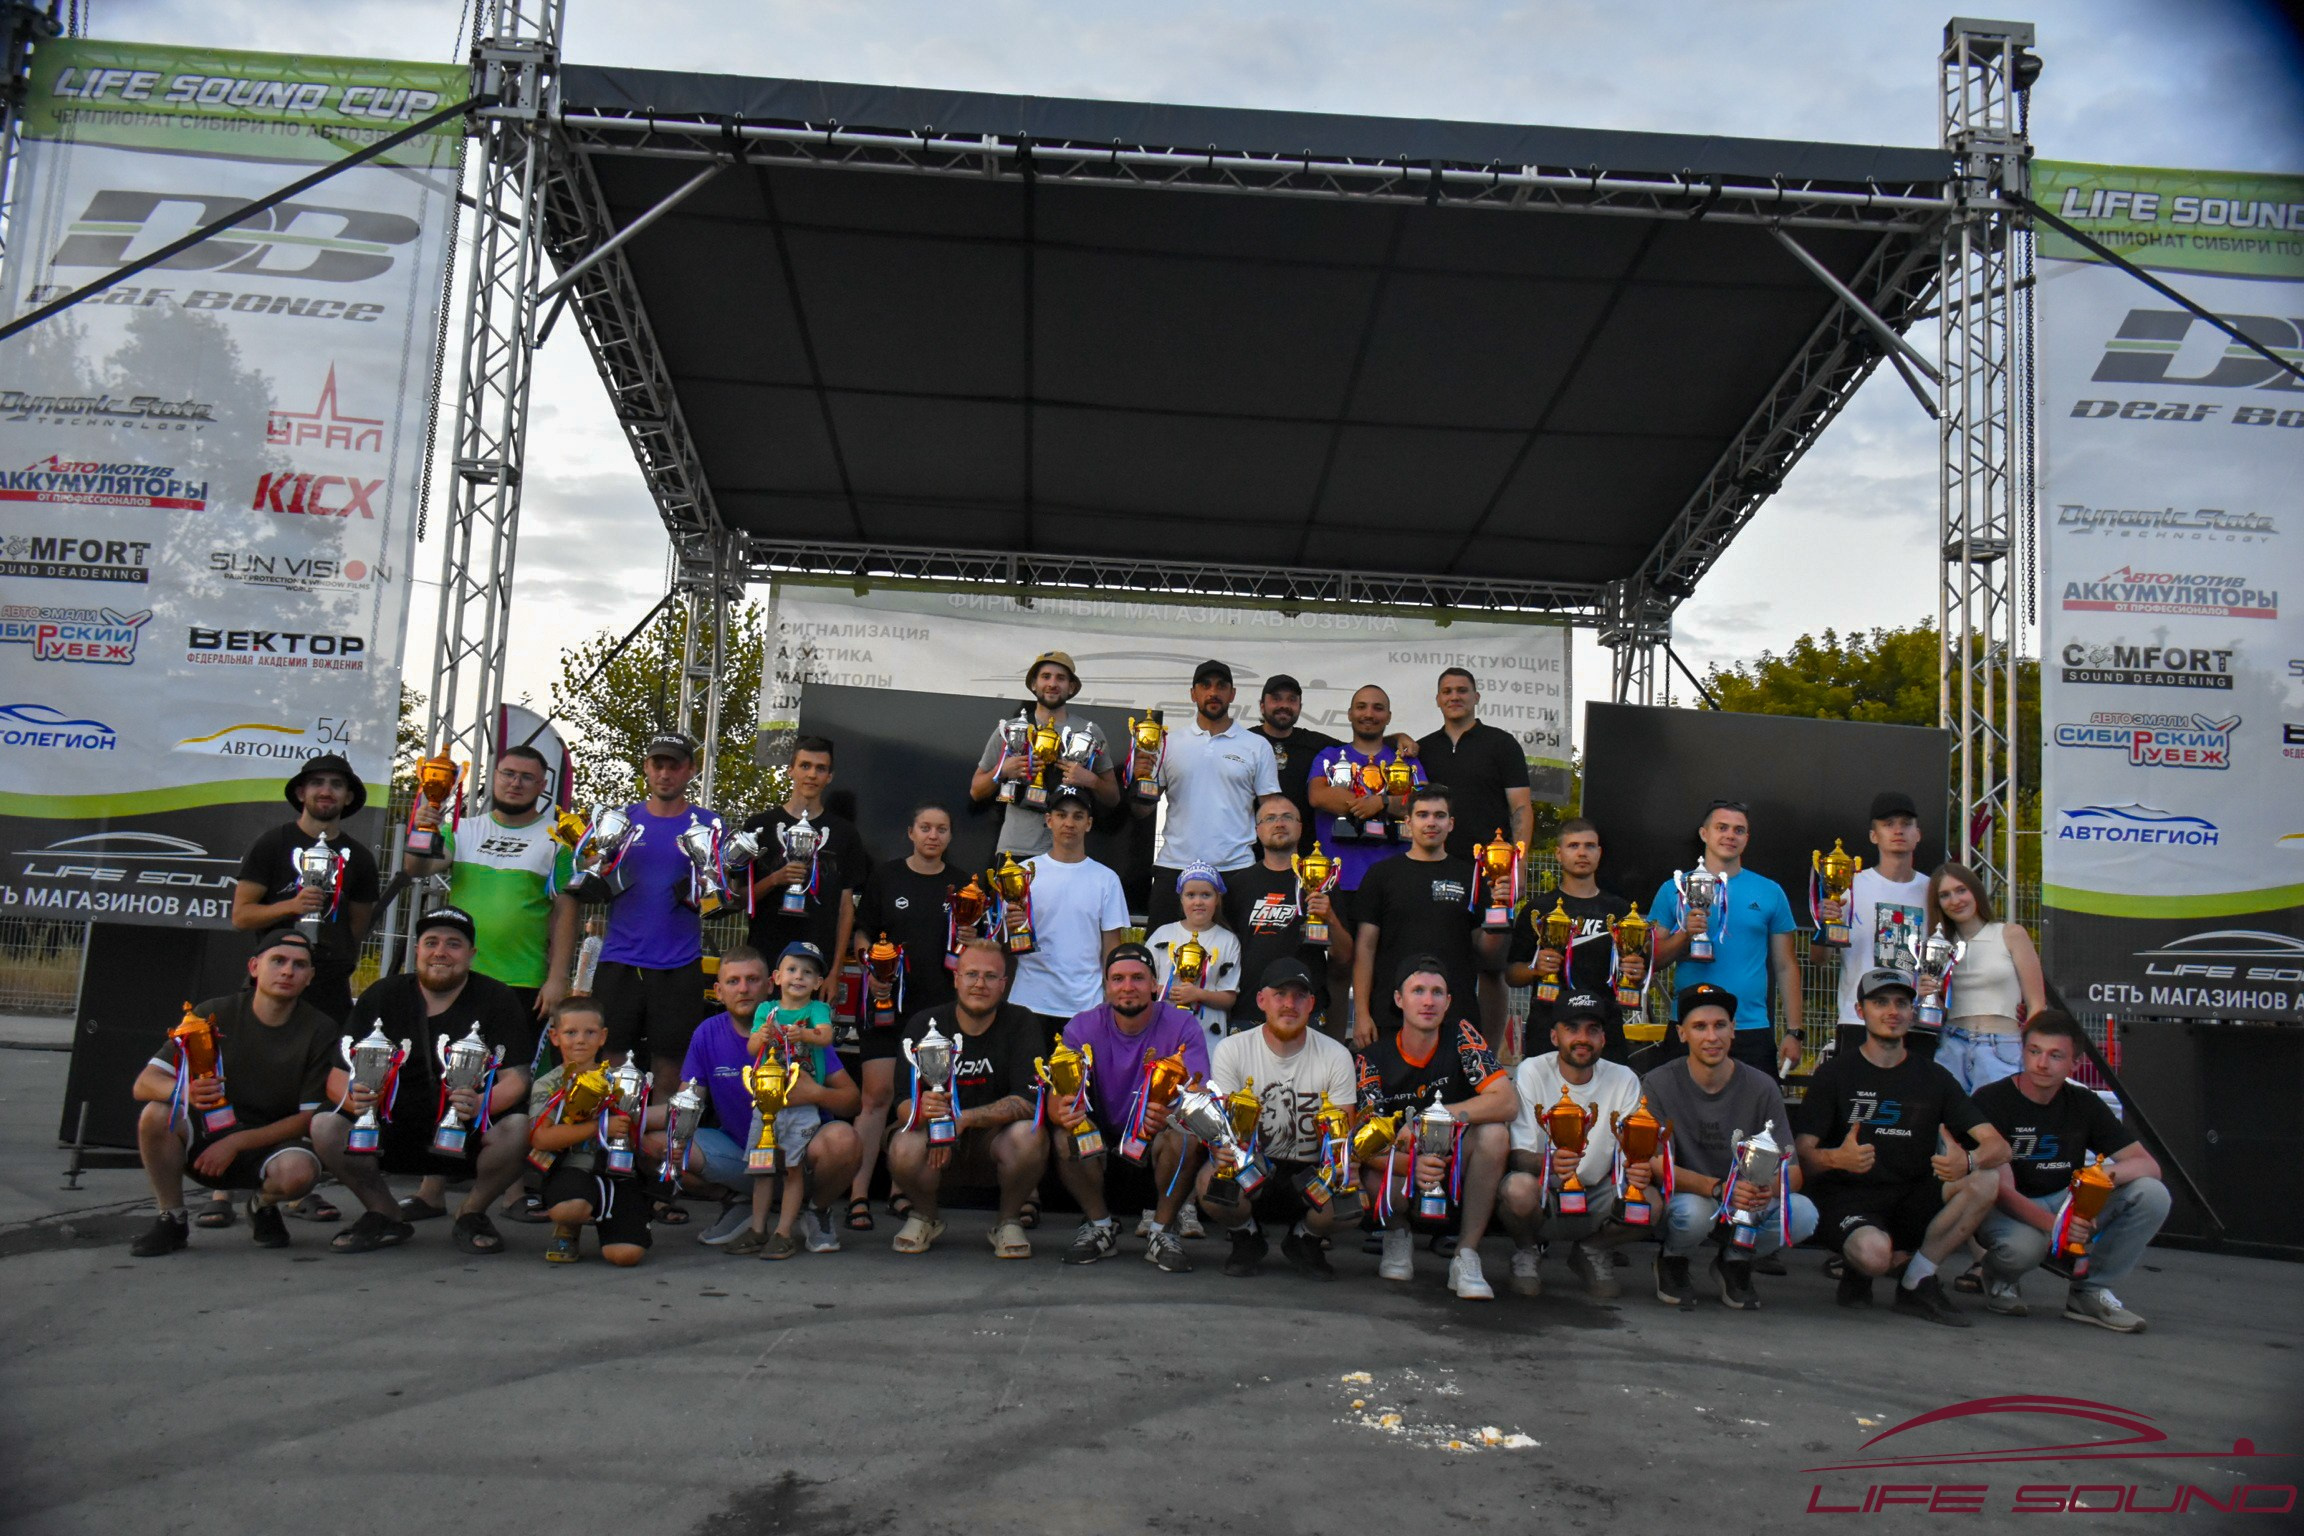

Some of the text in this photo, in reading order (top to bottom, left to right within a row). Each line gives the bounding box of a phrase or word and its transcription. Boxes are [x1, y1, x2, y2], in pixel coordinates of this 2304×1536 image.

[53, 67, 439, 120] LIFE SOUND CUP
[180, 115, 264, 135] СИБИРИ
[272, 120, 299, 136] ПО
[2060, 187, 2160, 221] LIFE
[2192, 236, 2271, 252] СИБИРИ
[38, 417, 204, 431] TECHNOLOGY
[37, 493, 152, 506] ОТ ПРОФЕССИОНАЛОВ
[252, 472, 386, 519] KICX
[2103, 529, 2269, 543] TECHNOLOGY
[209, 552, 275, 574] SUN
[47, 566, 141, 580] DEADENING
[249, 574, 298, 584] PROTECTION
[347, 583, 370, 591] FILMS
[2063, 582, 2278, 609] АККУМУЛЯТОРЫ
[1, 605, 98, 622] АВТОЭМАЛИ
[947, 592, 1399, 632] ФИРМЕННЫЙ МАГАЗИН АВТОЗВУКА
[2115, 603, 2229, 616] ОТ ПРОФЕССИОНАЛОВ
[780, 623, 930, 641] СИГНАЛИЗАЦИЯ
[188, 627, 365, 656] ВЕКТОР
[187, 653, 363, 671] ФЕДЕРАЛЬНАЯ АКАДЕМИЯ ВОЖДЕНИЯ
[1388, 651, 1560, 673] КОМПЛЕКТУЮЩИЕ
[2069, 671, 2226, 687] SOUND DEADENING
[2090, 712, 2188, 728] АВТОЭМАЛИ
[317, 717, 350, 745] 54
[2058, 825, 2219, 847] АВТОЛЕГИОН
[23, 863, 127, 882] LIFE
[24, 887, 180, 915] МАГАЗИНОВ
[2145, 963, 2236, 979] LIFE
[2088, 984, 2144, 1004] СЕТЬ
[2150, 986, 2287, 1010] МАГАЗИНОВ
[1875, 1128, 1912, 1136] RUSSIA
[2036, 1161, 2071, 1170] RUSSIA
